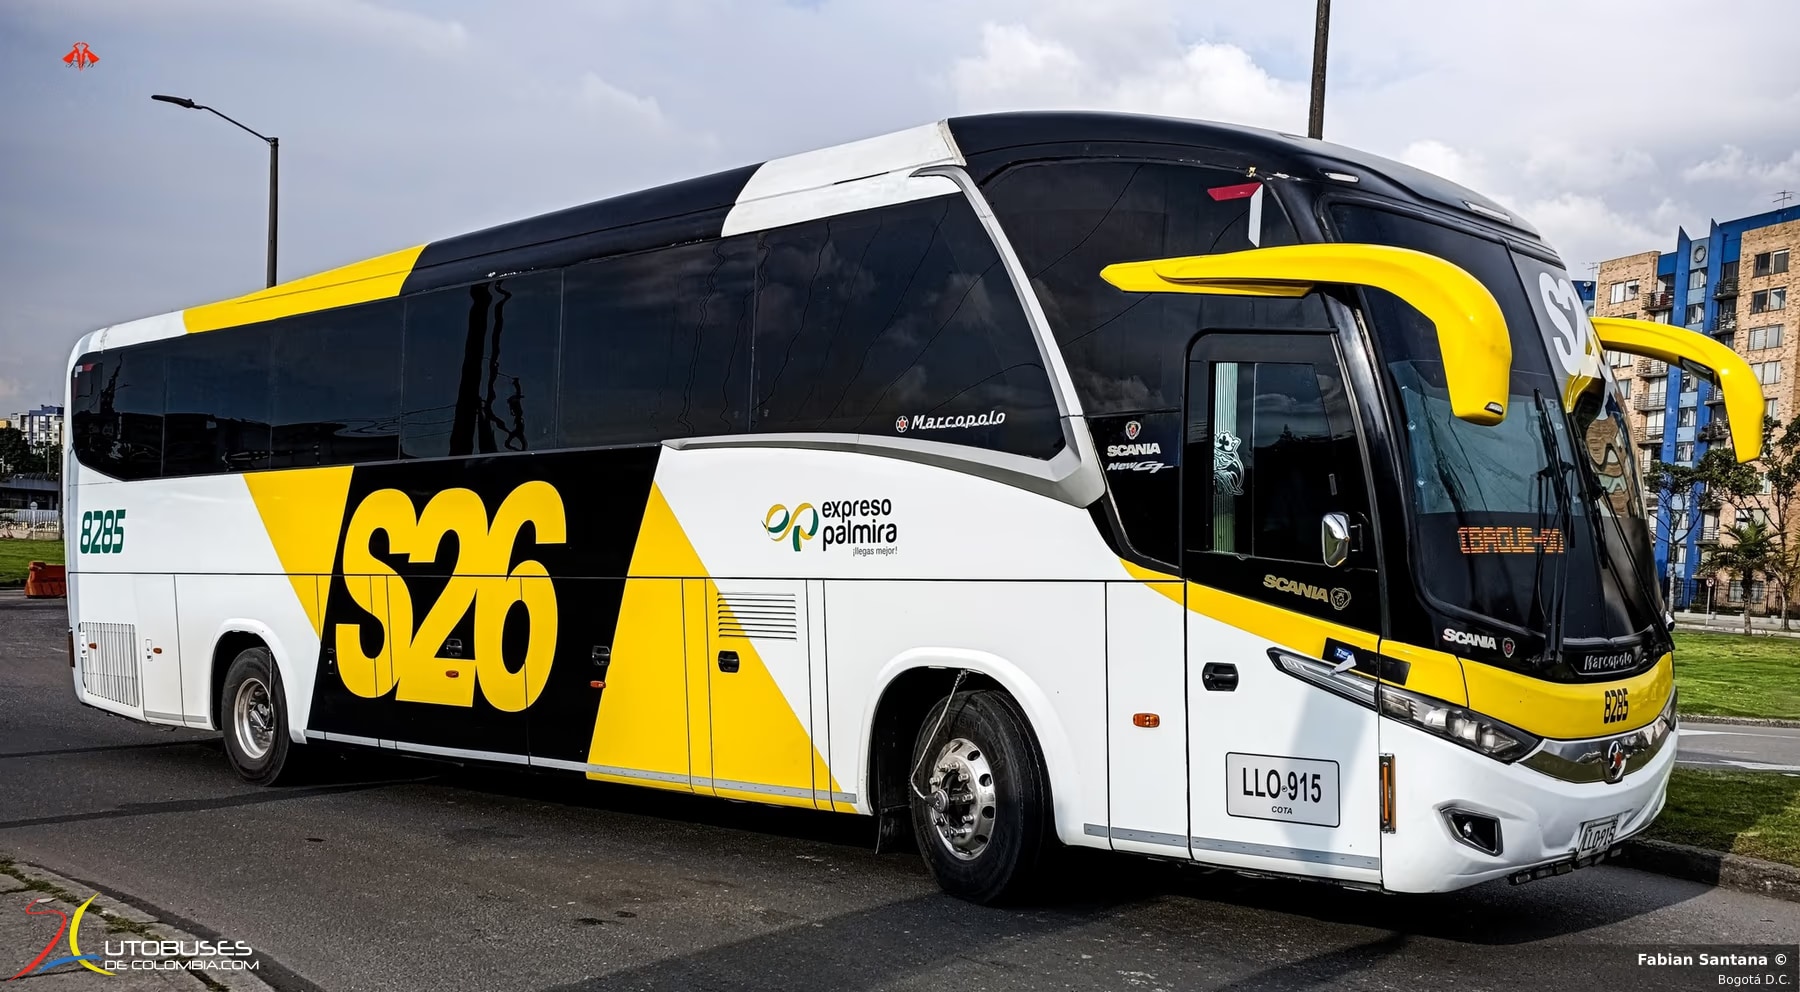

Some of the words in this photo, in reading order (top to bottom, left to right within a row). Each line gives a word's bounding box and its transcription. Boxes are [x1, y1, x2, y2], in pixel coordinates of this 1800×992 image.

[911, 410, 1006, 430] Marcopolo
[1107, 442, 1161, 457] SCANIA
[822, 499, 892, 523] expreso
[80, 509, 126, 554] 8285
[823, 519, 897, 551] palmira
[876, 546, 897, 557] mejor!
[336, 481, 566, 712] S26
[1263, 574, 1329, 602] SCANIA
[1442, 628, 1497, 650] SCANIA
[1584, 652, 1632, 671] Marcopolo
[1603, 688, 1629, 724] 8285
[1271, 806, 1293, 815] COTA
